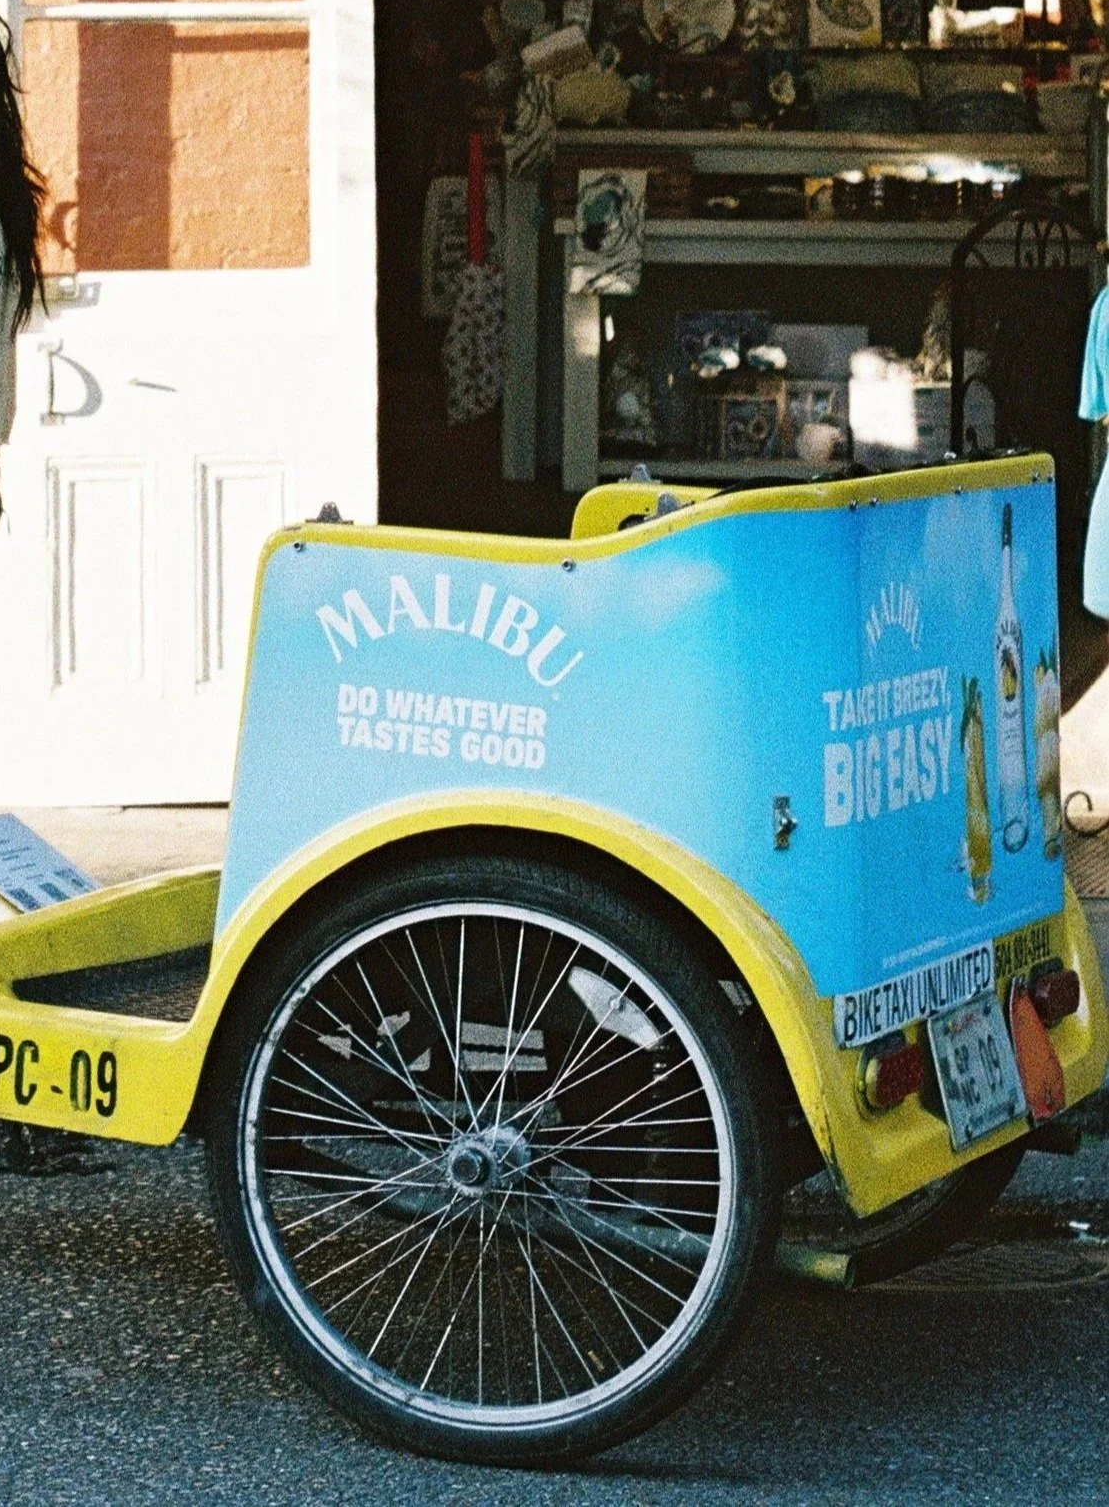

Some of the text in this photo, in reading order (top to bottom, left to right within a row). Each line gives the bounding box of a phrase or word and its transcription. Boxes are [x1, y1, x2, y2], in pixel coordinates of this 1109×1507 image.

[315, 573, 584, 687] MALIBU
[337, 683, 548, 738] DO WHATEVER
[337, 716, 546, 770] TASTES GOOD
[822, 684, 875, 732] TAKE
[877, 679, 891, 722] IT
[823, 734, 882, 828] BIG
[886, 713, 953, 812] EASY
[843, 986, 881, 1042] BIKE
[883, 974, 915, 1031] TAXI
[917, 946, 991, 1017] UNLIMITED
